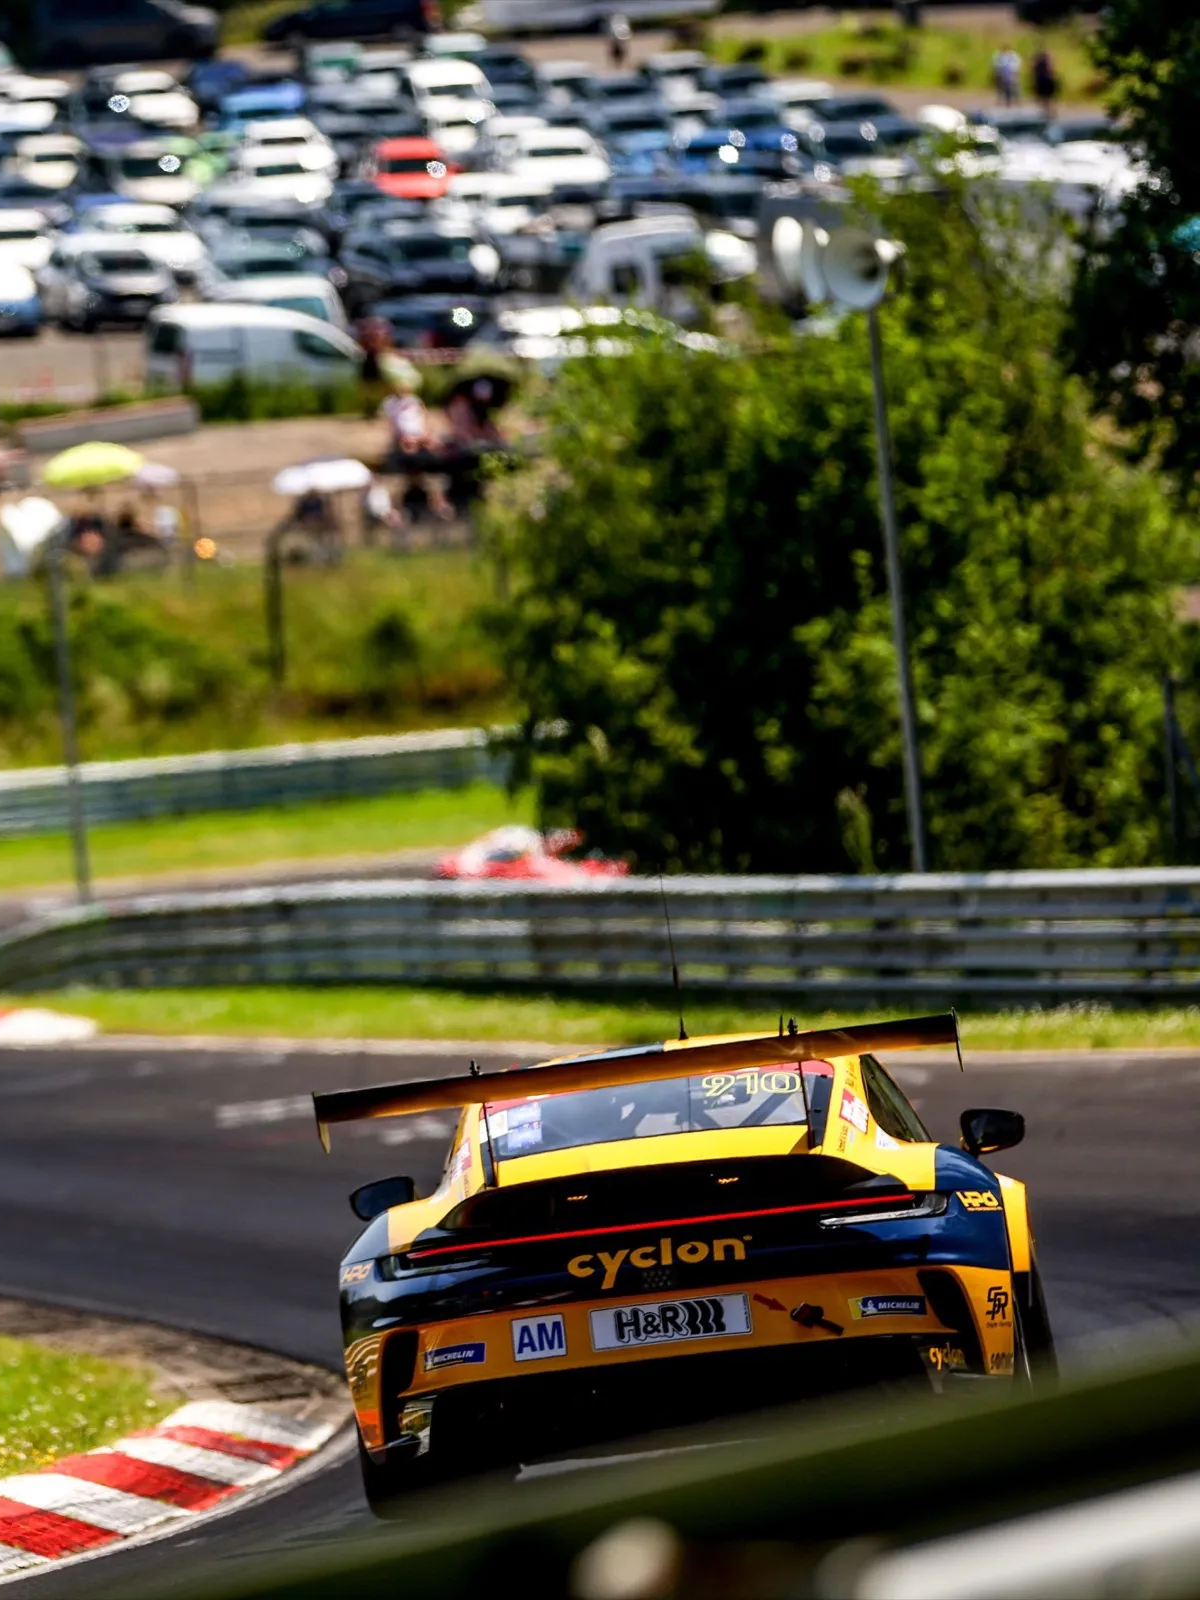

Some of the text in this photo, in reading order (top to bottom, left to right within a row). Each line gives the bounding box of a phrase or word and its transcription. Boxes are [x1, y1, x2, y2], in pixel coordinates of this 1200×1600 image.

[702, 1072, 801, 1097] 910
[567, 1236, 747, 1289] cyclon
[517, 1320, 564, 1354] AM
[614, 1304, 689, 1343] H&R
[433, 1350, 475, 1364] MICHELIN
